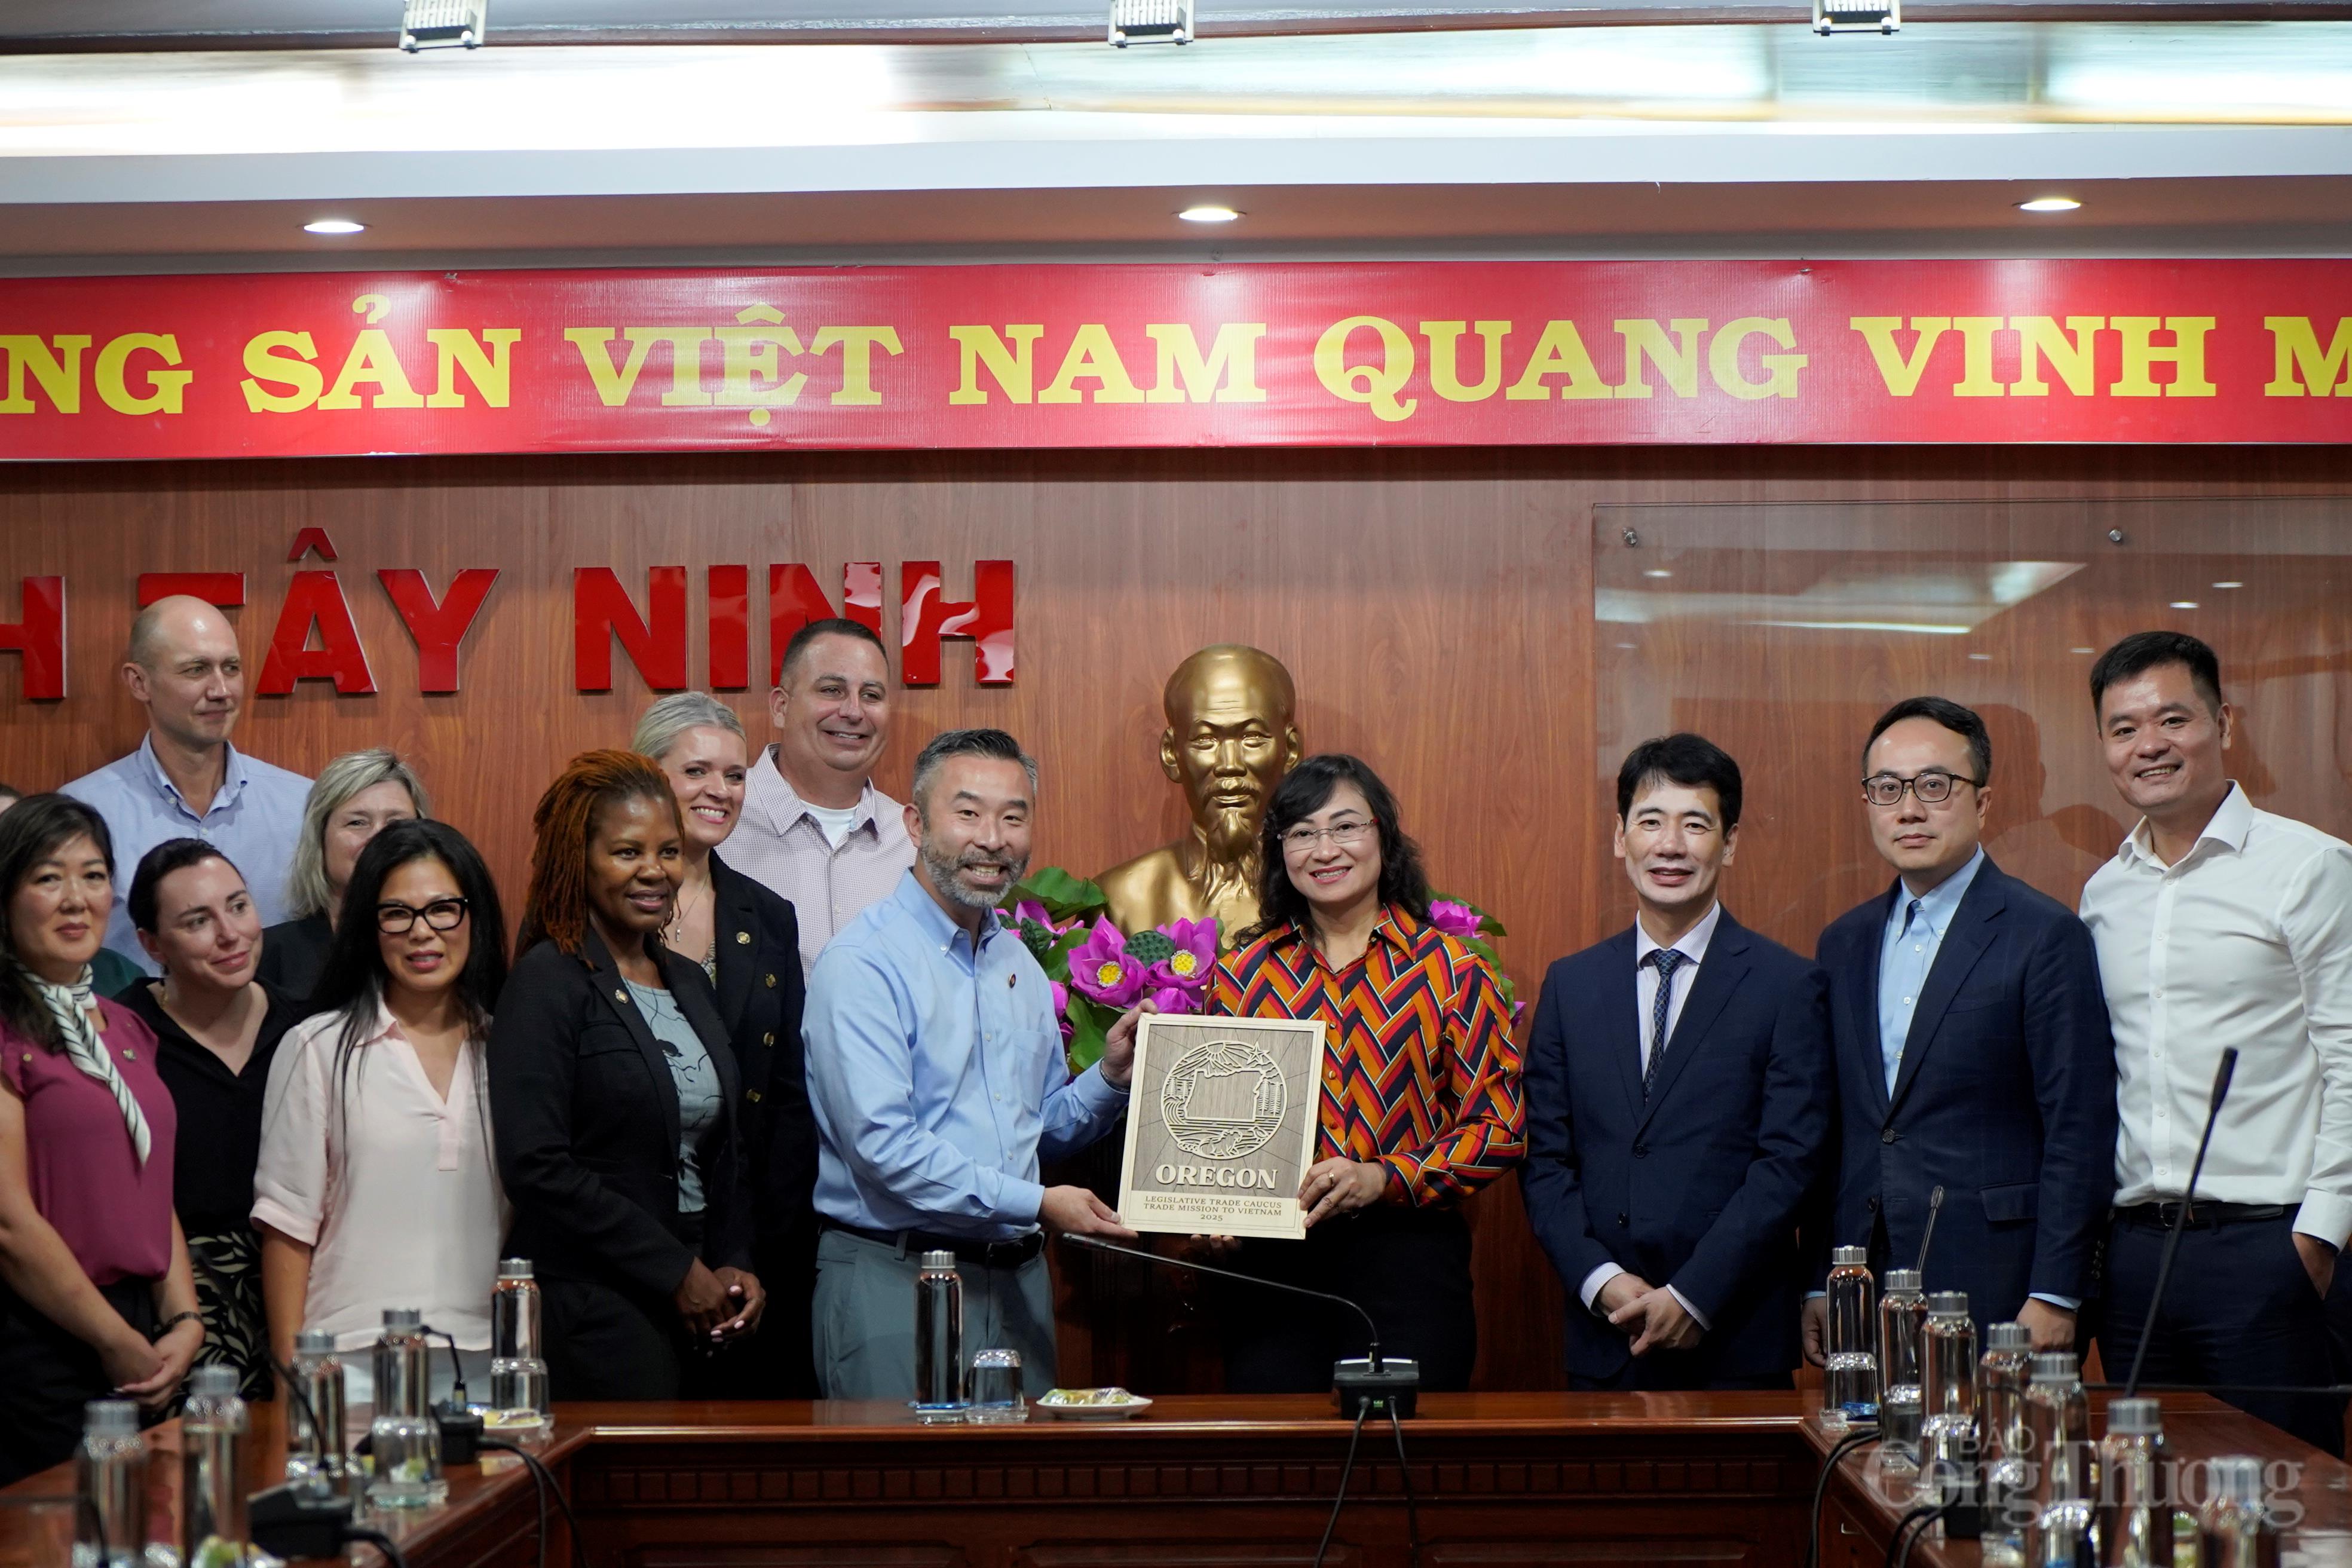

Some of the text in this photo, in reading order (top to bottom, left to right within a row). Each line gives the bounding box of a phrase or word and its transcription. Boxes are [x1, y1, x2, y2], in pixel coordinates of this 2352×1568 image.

[240, 294, 521, 413] SẢN
[564, 301, 904, 427] VIỆT
[950, 323, 1266, 405] NAM
[1313, 316, 1808, 421] QUANG
[1849, 316, 2216, 397] VINH
[574, 560, 1014, 691] NINH
[1146, 1196, 1206, 1205] LEGISLATIVE
[1156, 1164, 1278, 1190] OREGON
